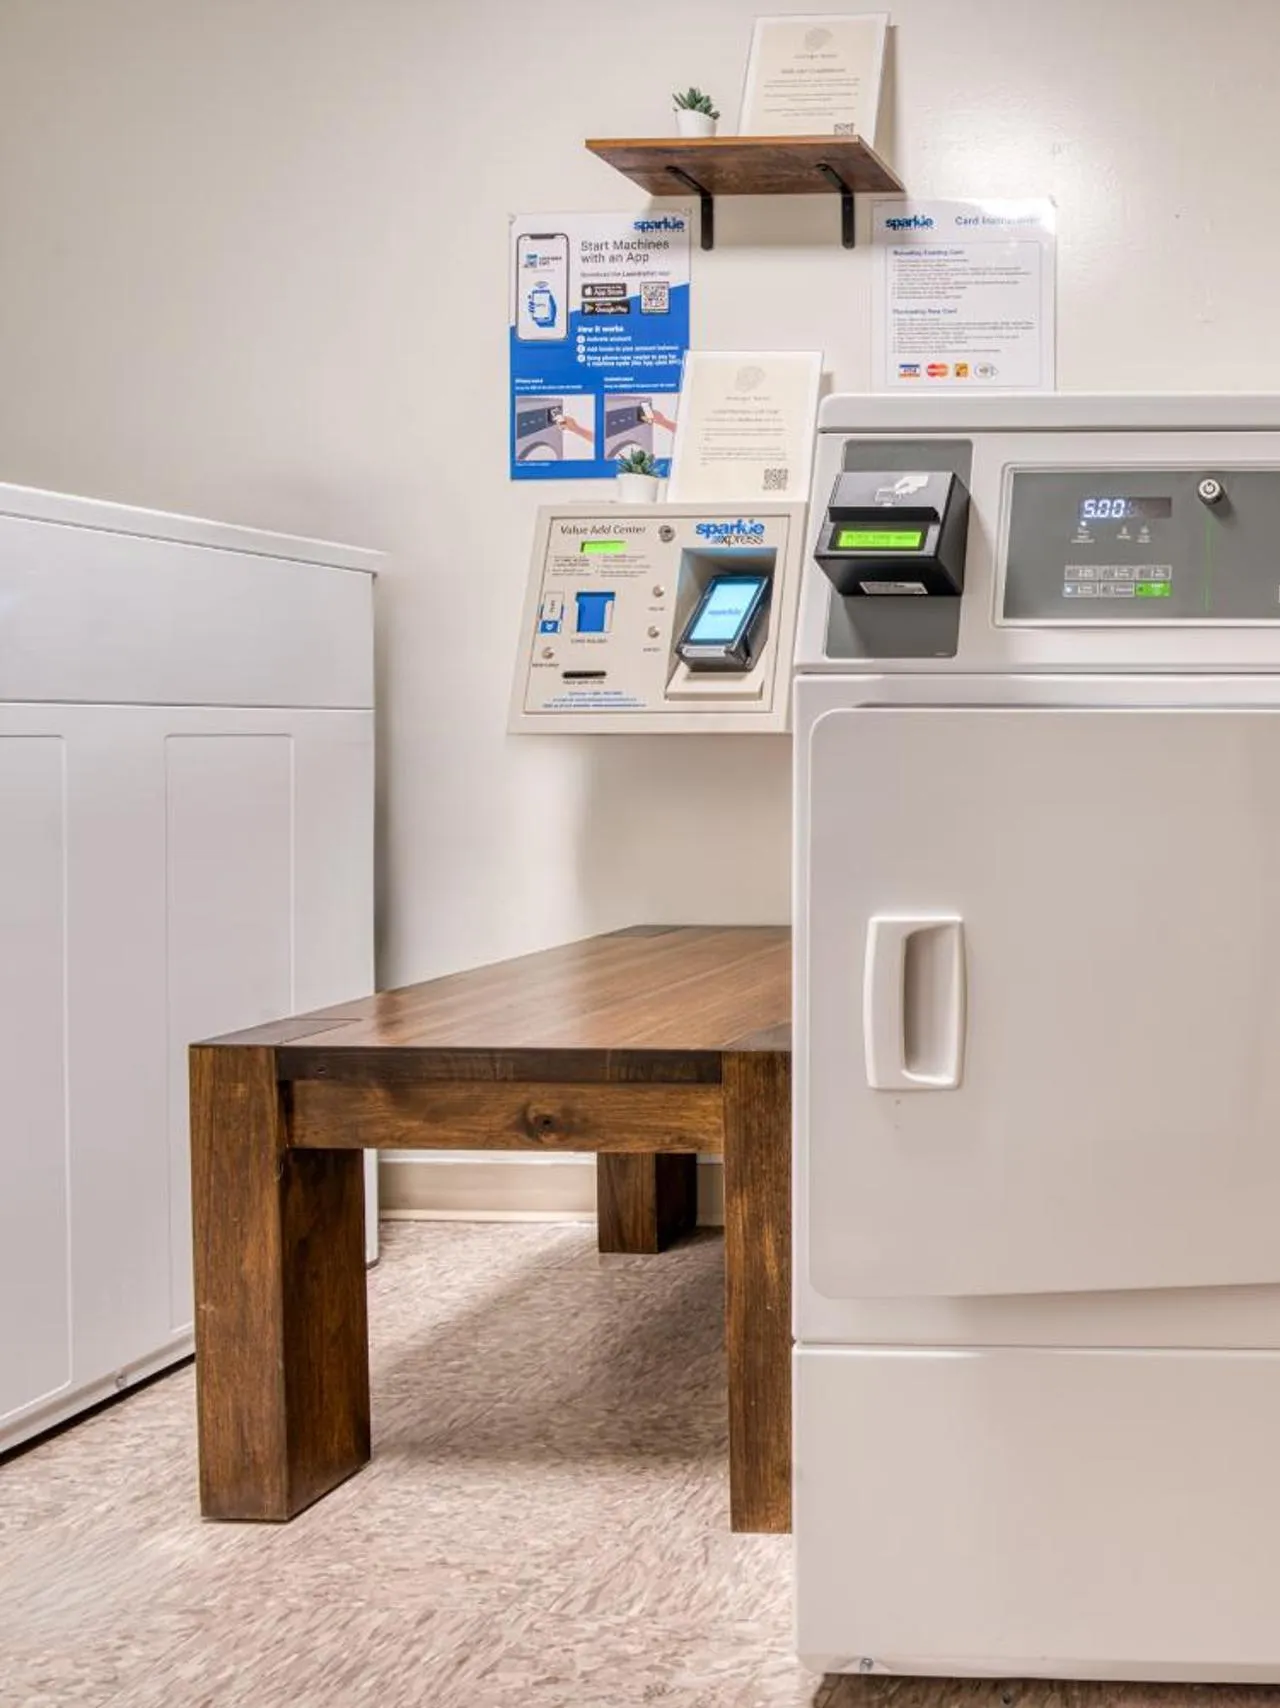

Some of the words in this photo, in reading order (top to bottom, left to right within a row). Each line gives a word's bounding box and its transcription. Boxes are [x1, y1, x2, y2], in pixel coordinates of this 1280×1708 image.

[955, 216, 978, 225] Card
[581, 241, 609, 251] Start
[613, 239, 669, 250] Machines
[581, 253, 605, 263] with
[609, 254, 623, 263] an
[626, 252, 649, 264] App
[560, 525, 588, 534] Value
[590, 525, 612, 534] Add
[613, 525, 647, 533] Center
